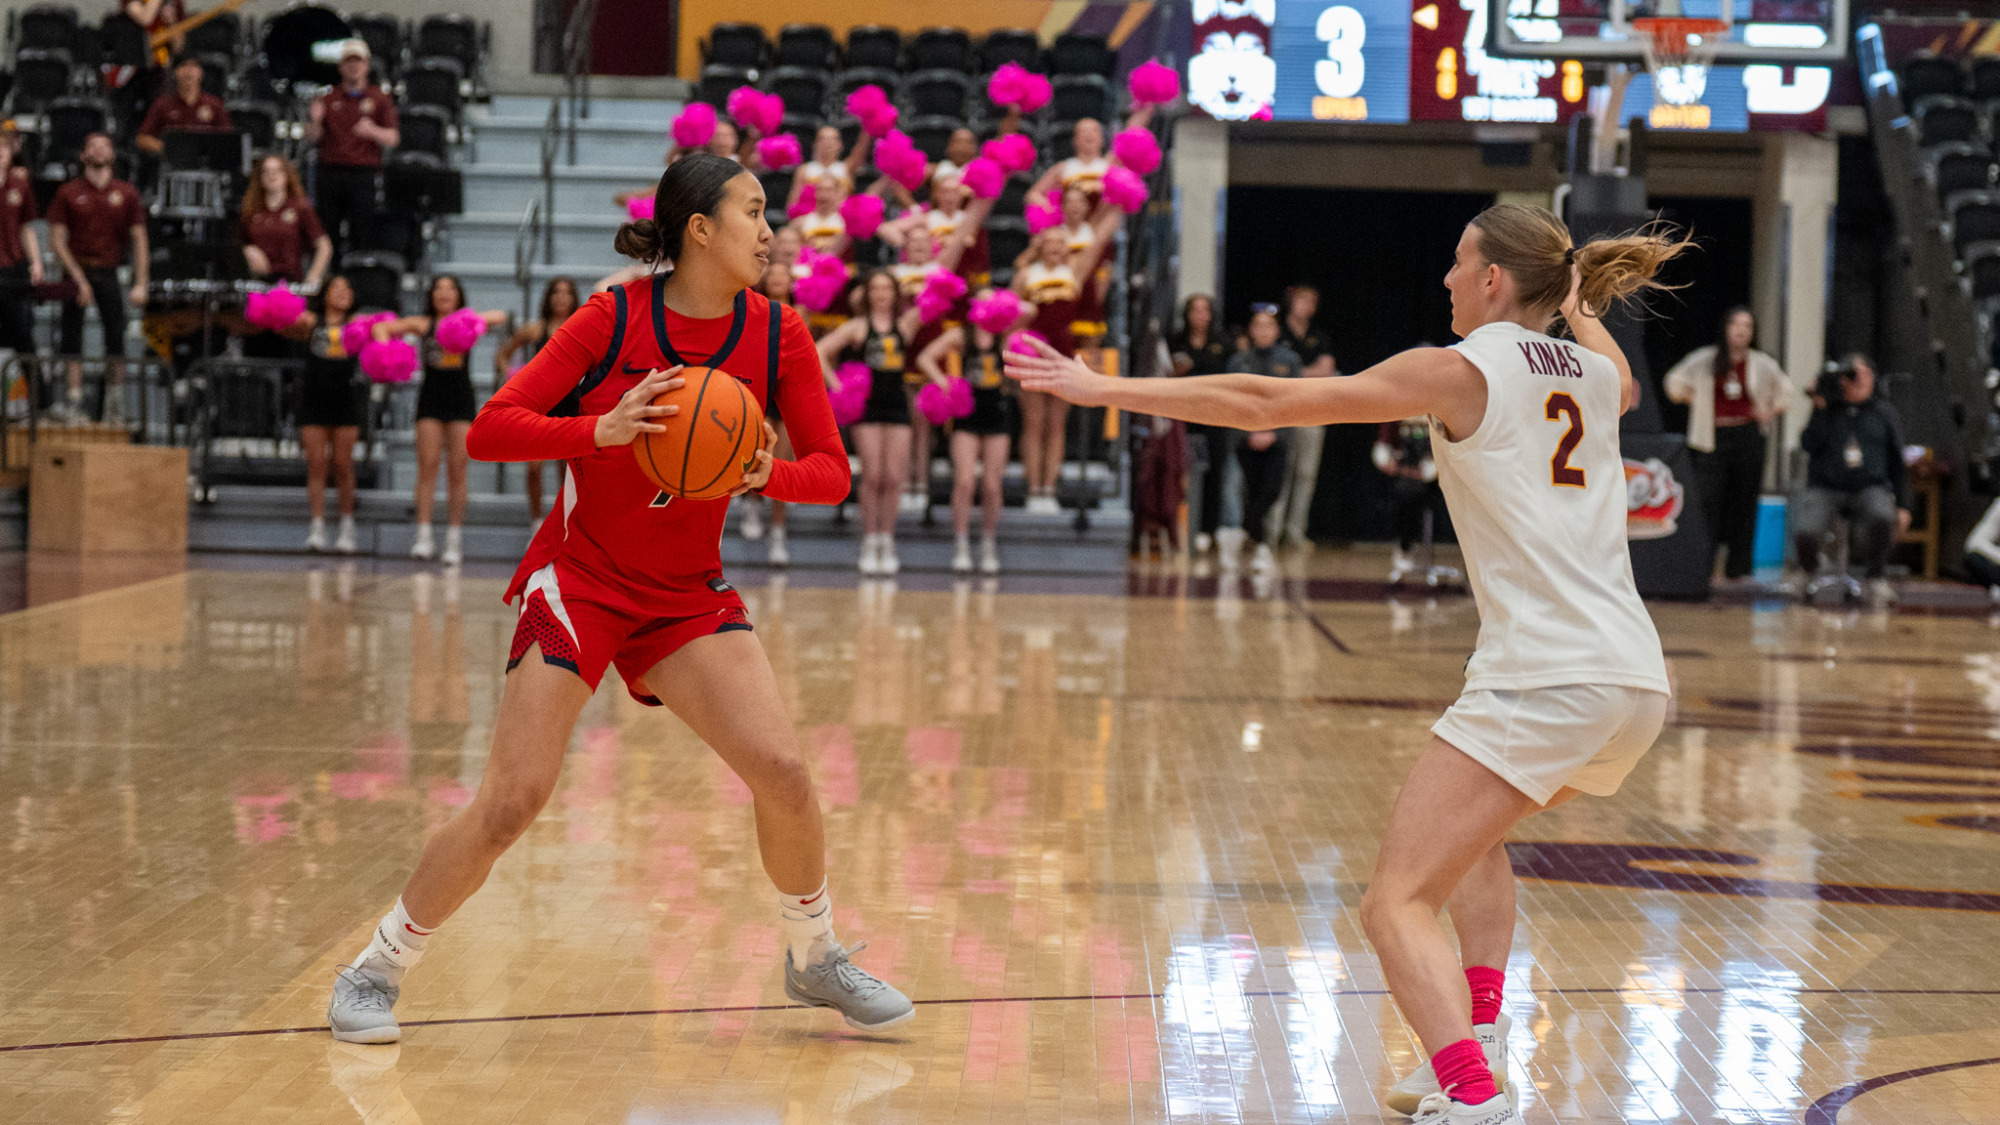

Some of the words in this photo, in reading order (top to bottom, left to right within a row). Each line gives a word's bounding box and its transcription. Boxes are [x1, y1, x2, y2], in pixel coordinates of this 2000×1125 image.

[1315, 5, 1366, 98] 3
[1517, 342, 1583, 378] KINAS
[1544, 391, 1586, 489] 2
